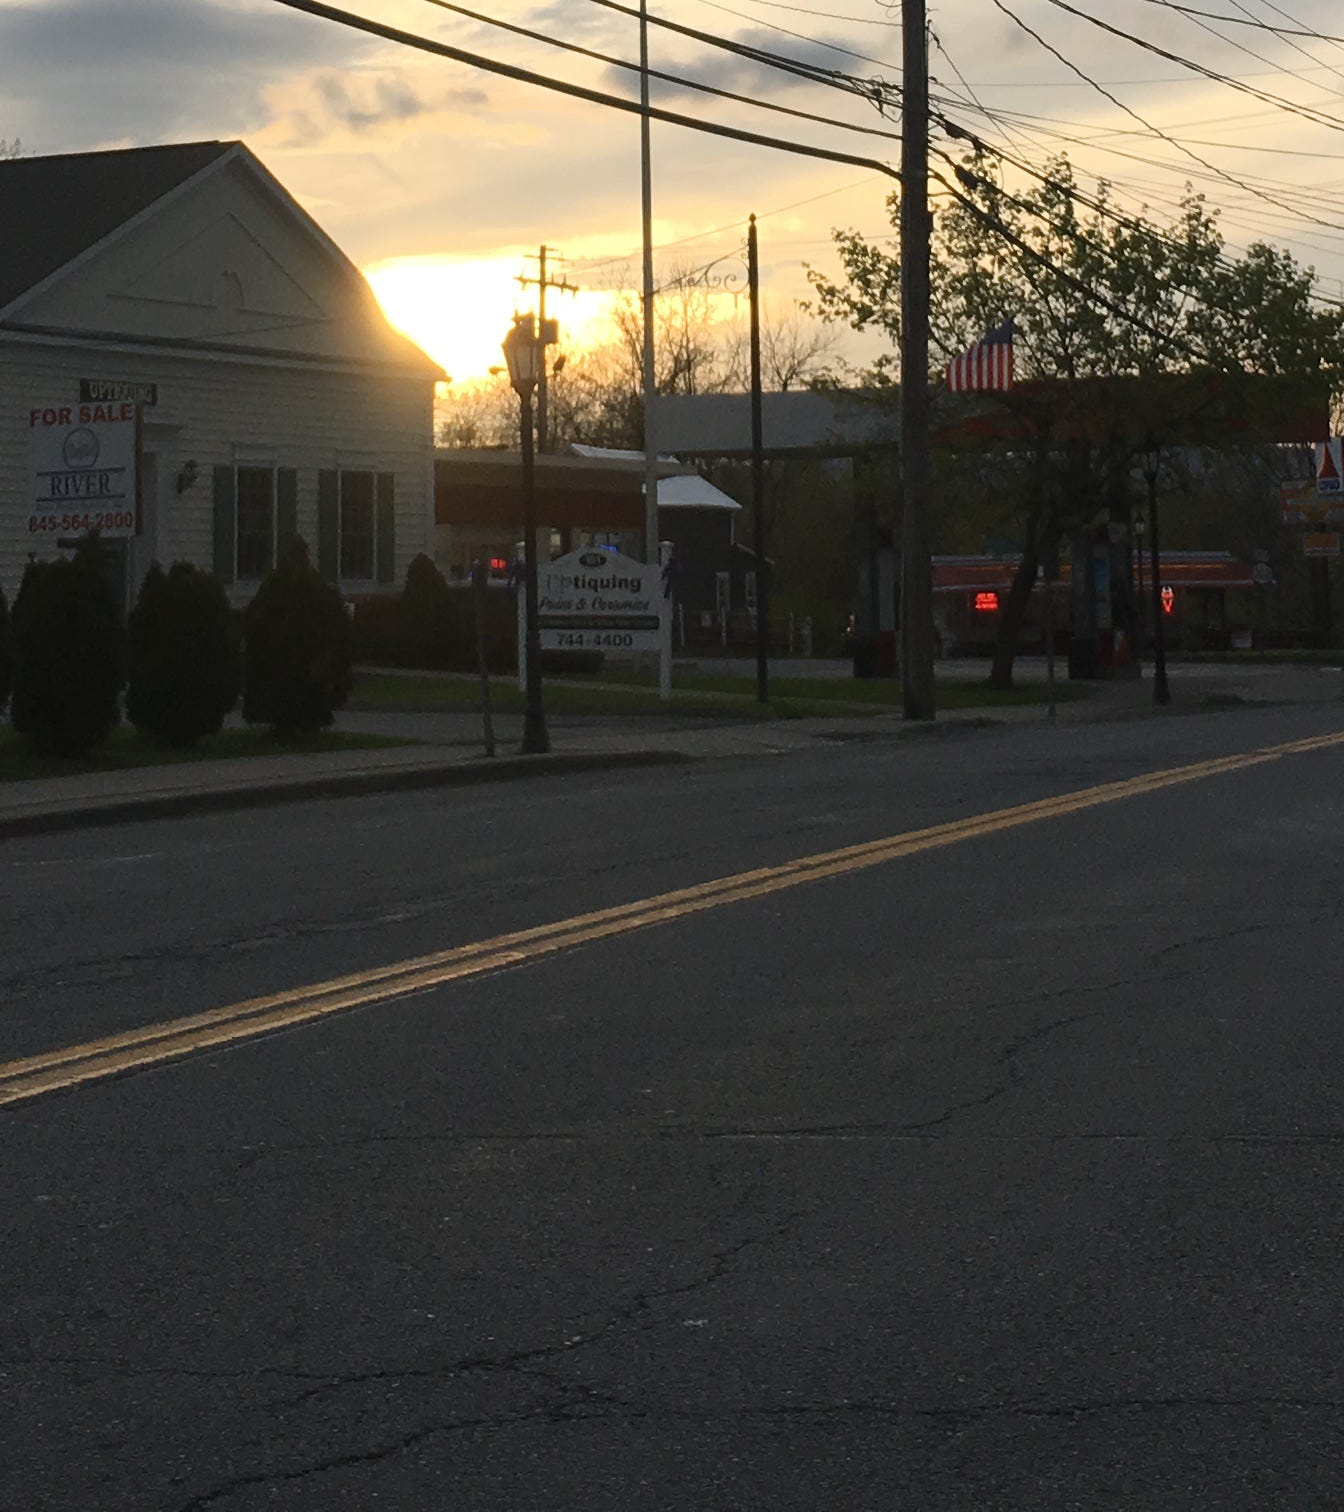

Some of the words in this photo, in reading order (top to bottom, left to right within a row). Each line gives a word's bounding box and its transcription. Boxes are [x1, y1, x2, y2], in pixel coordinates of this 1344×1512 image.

[29, 407, 72, 426] FOR
[79, 404, 134, 424] SALE
[51, 473, 111, 496] RIVER
[29, 511, 134, 532] 845-564-2800
[558, 633, 633, 646] 744-4400
